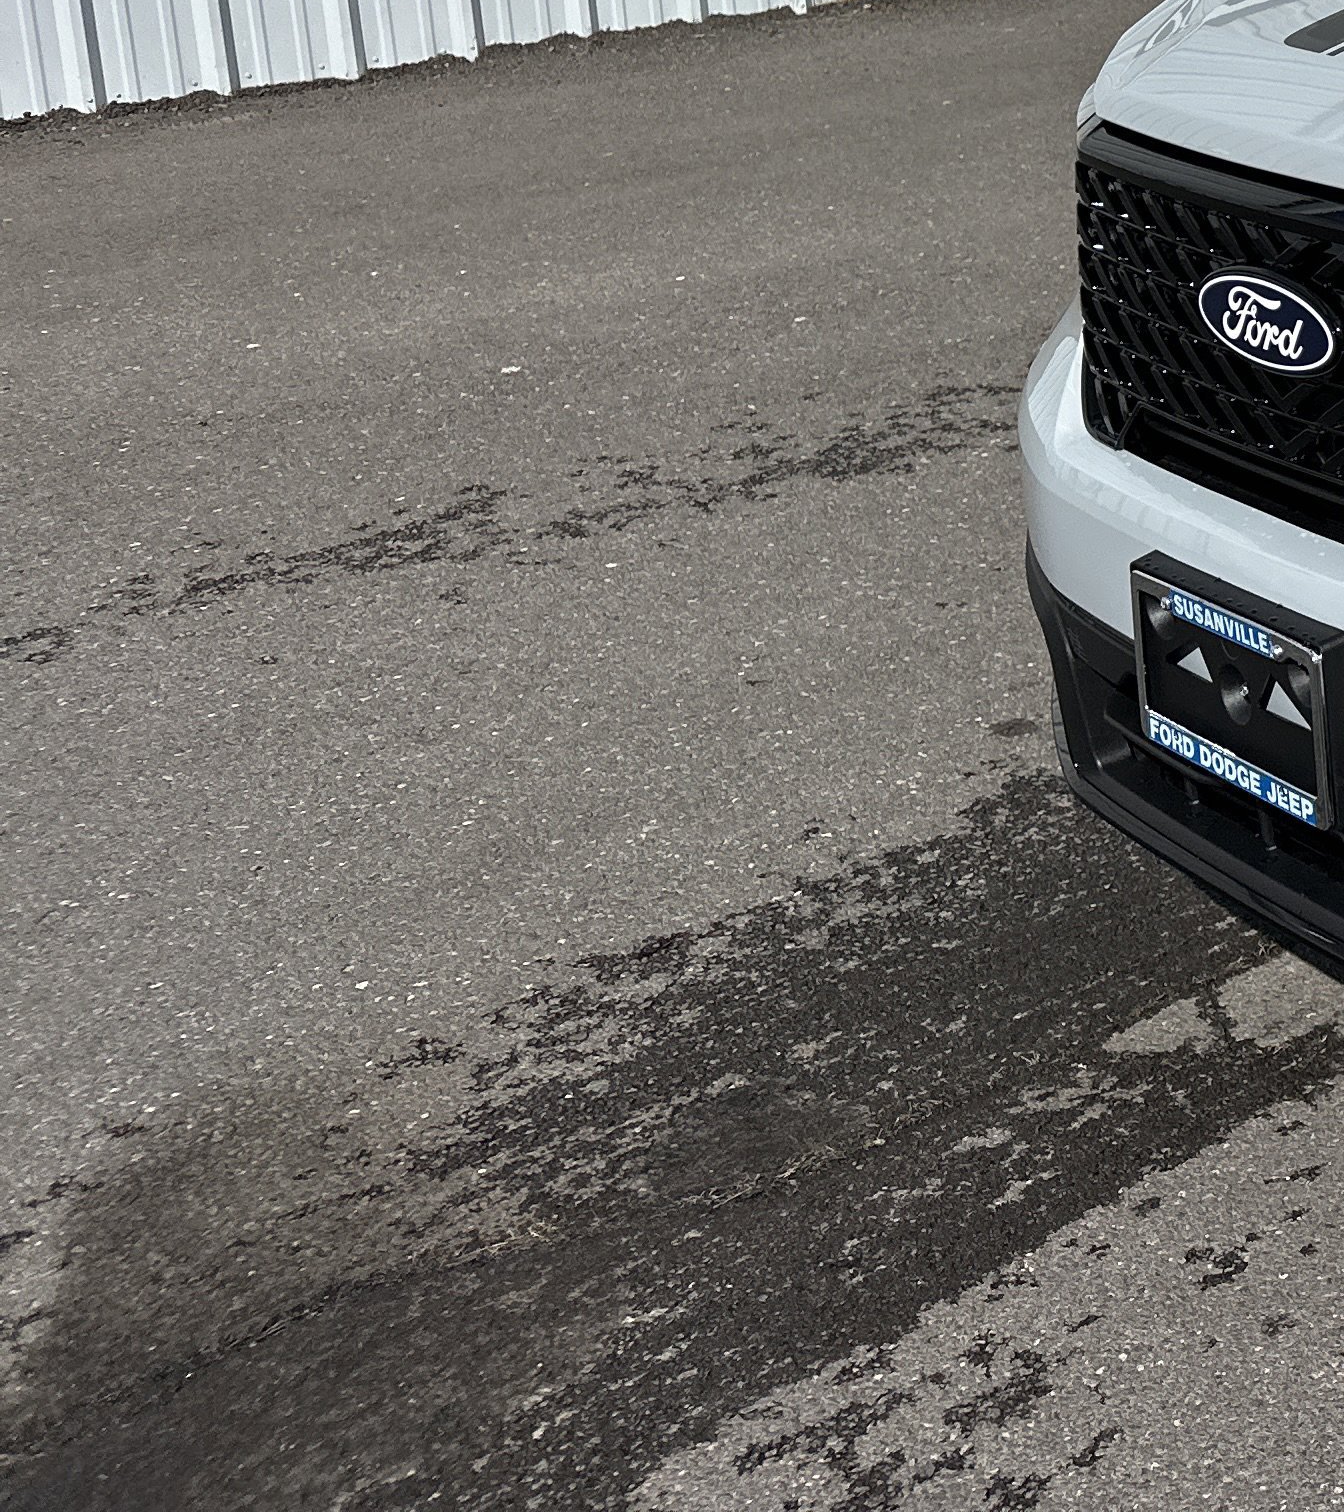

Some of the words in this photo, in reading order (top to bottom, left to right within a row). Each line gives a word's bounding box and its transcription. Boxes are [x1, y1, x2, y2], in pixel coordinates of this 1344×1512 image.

[1222, 285, 1304, 360] Ford
[1172, 594, 1270, 654] SUSANVILLE
[1149, 717, 1195, 759] FORD
[1199, 744, 1262, 796] DODGE
[1266, 781, 1315, 820] JEEP
